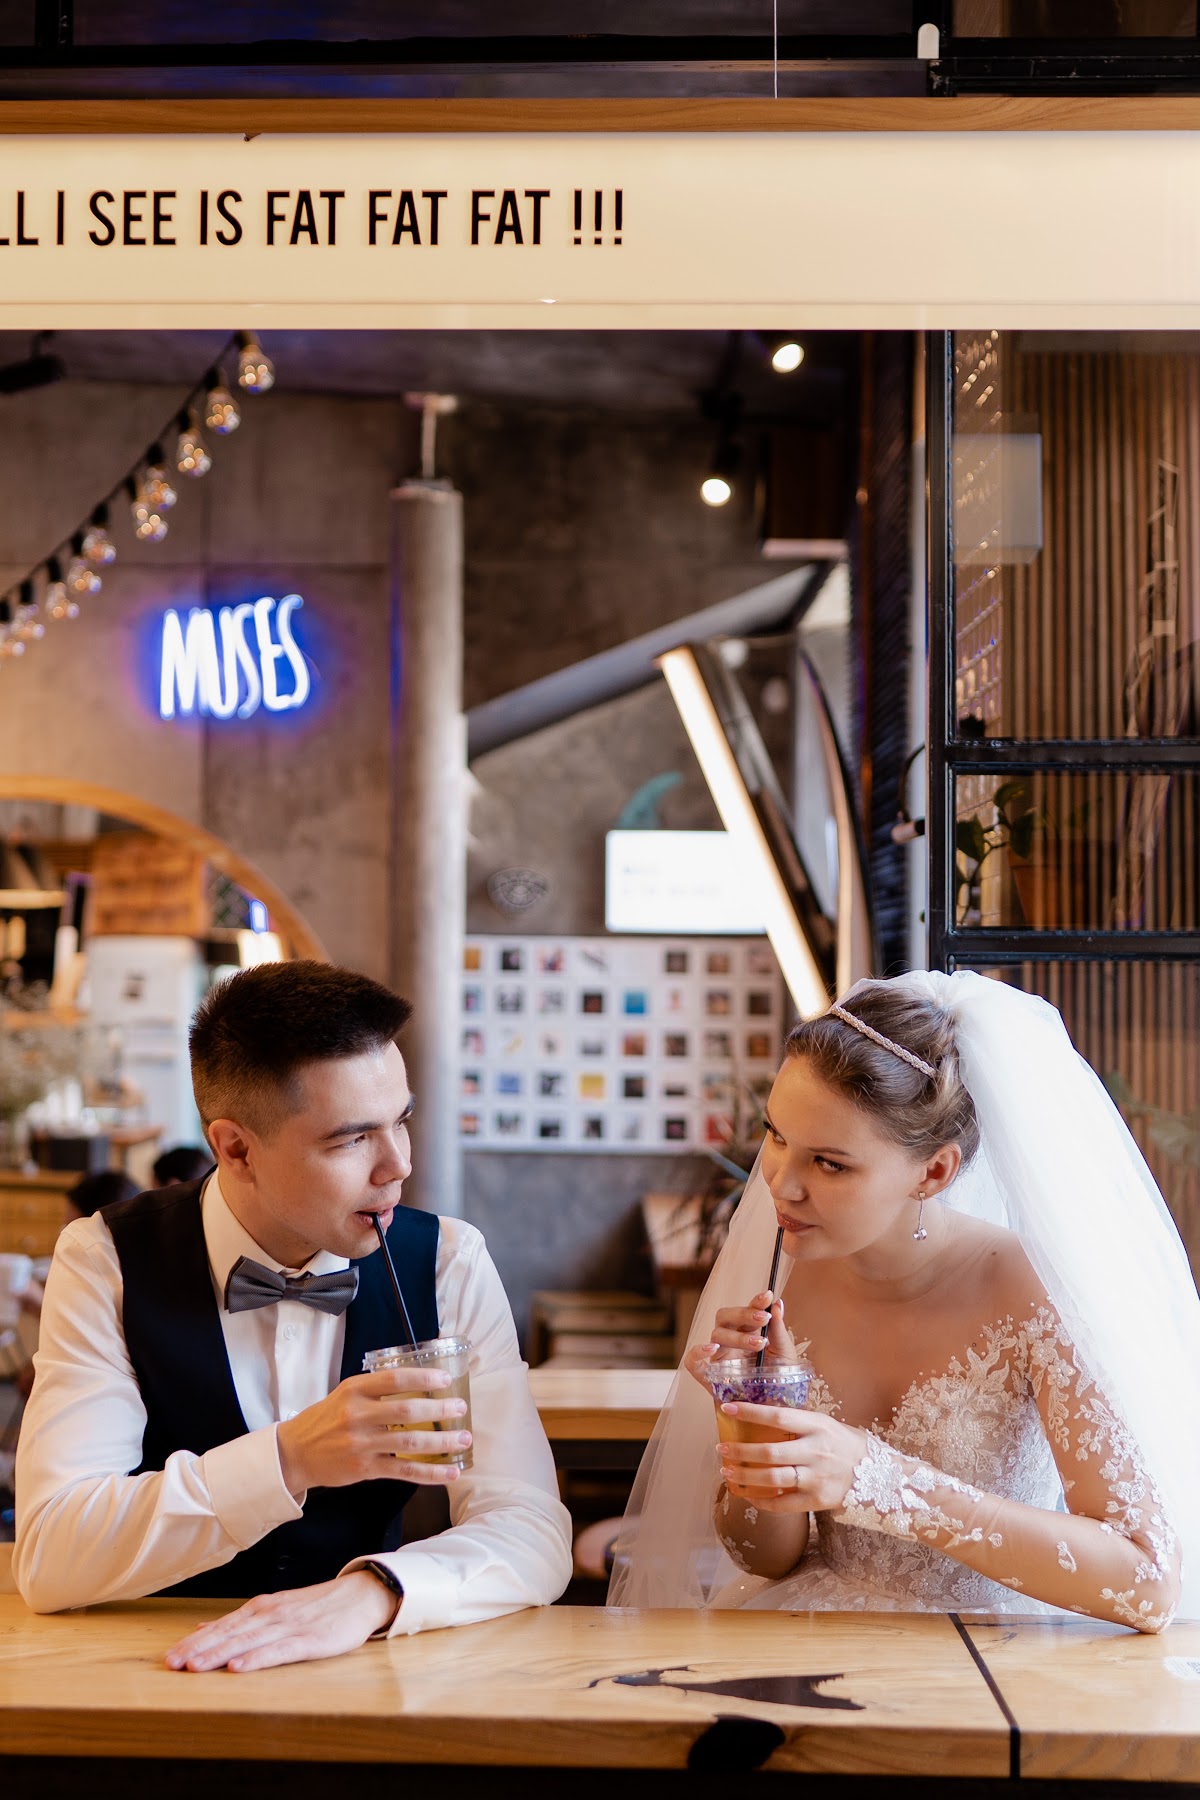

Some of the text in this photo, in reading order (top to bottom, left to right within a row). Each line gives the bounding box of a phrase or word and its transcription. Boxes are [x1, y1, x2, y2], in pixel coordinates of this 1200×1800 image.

[56, 190, 65, 246] I
[88, 189, 177, 247] SEE
[199, 189, 243, 246] IS
[265, 189, 345, 246] FAT
[367, 189, 448, 246] FAT
[470, 189, 551, 246] FAT
[572, 188, 623, 246] !!!
[159, 594, 311, 721] MUSES
